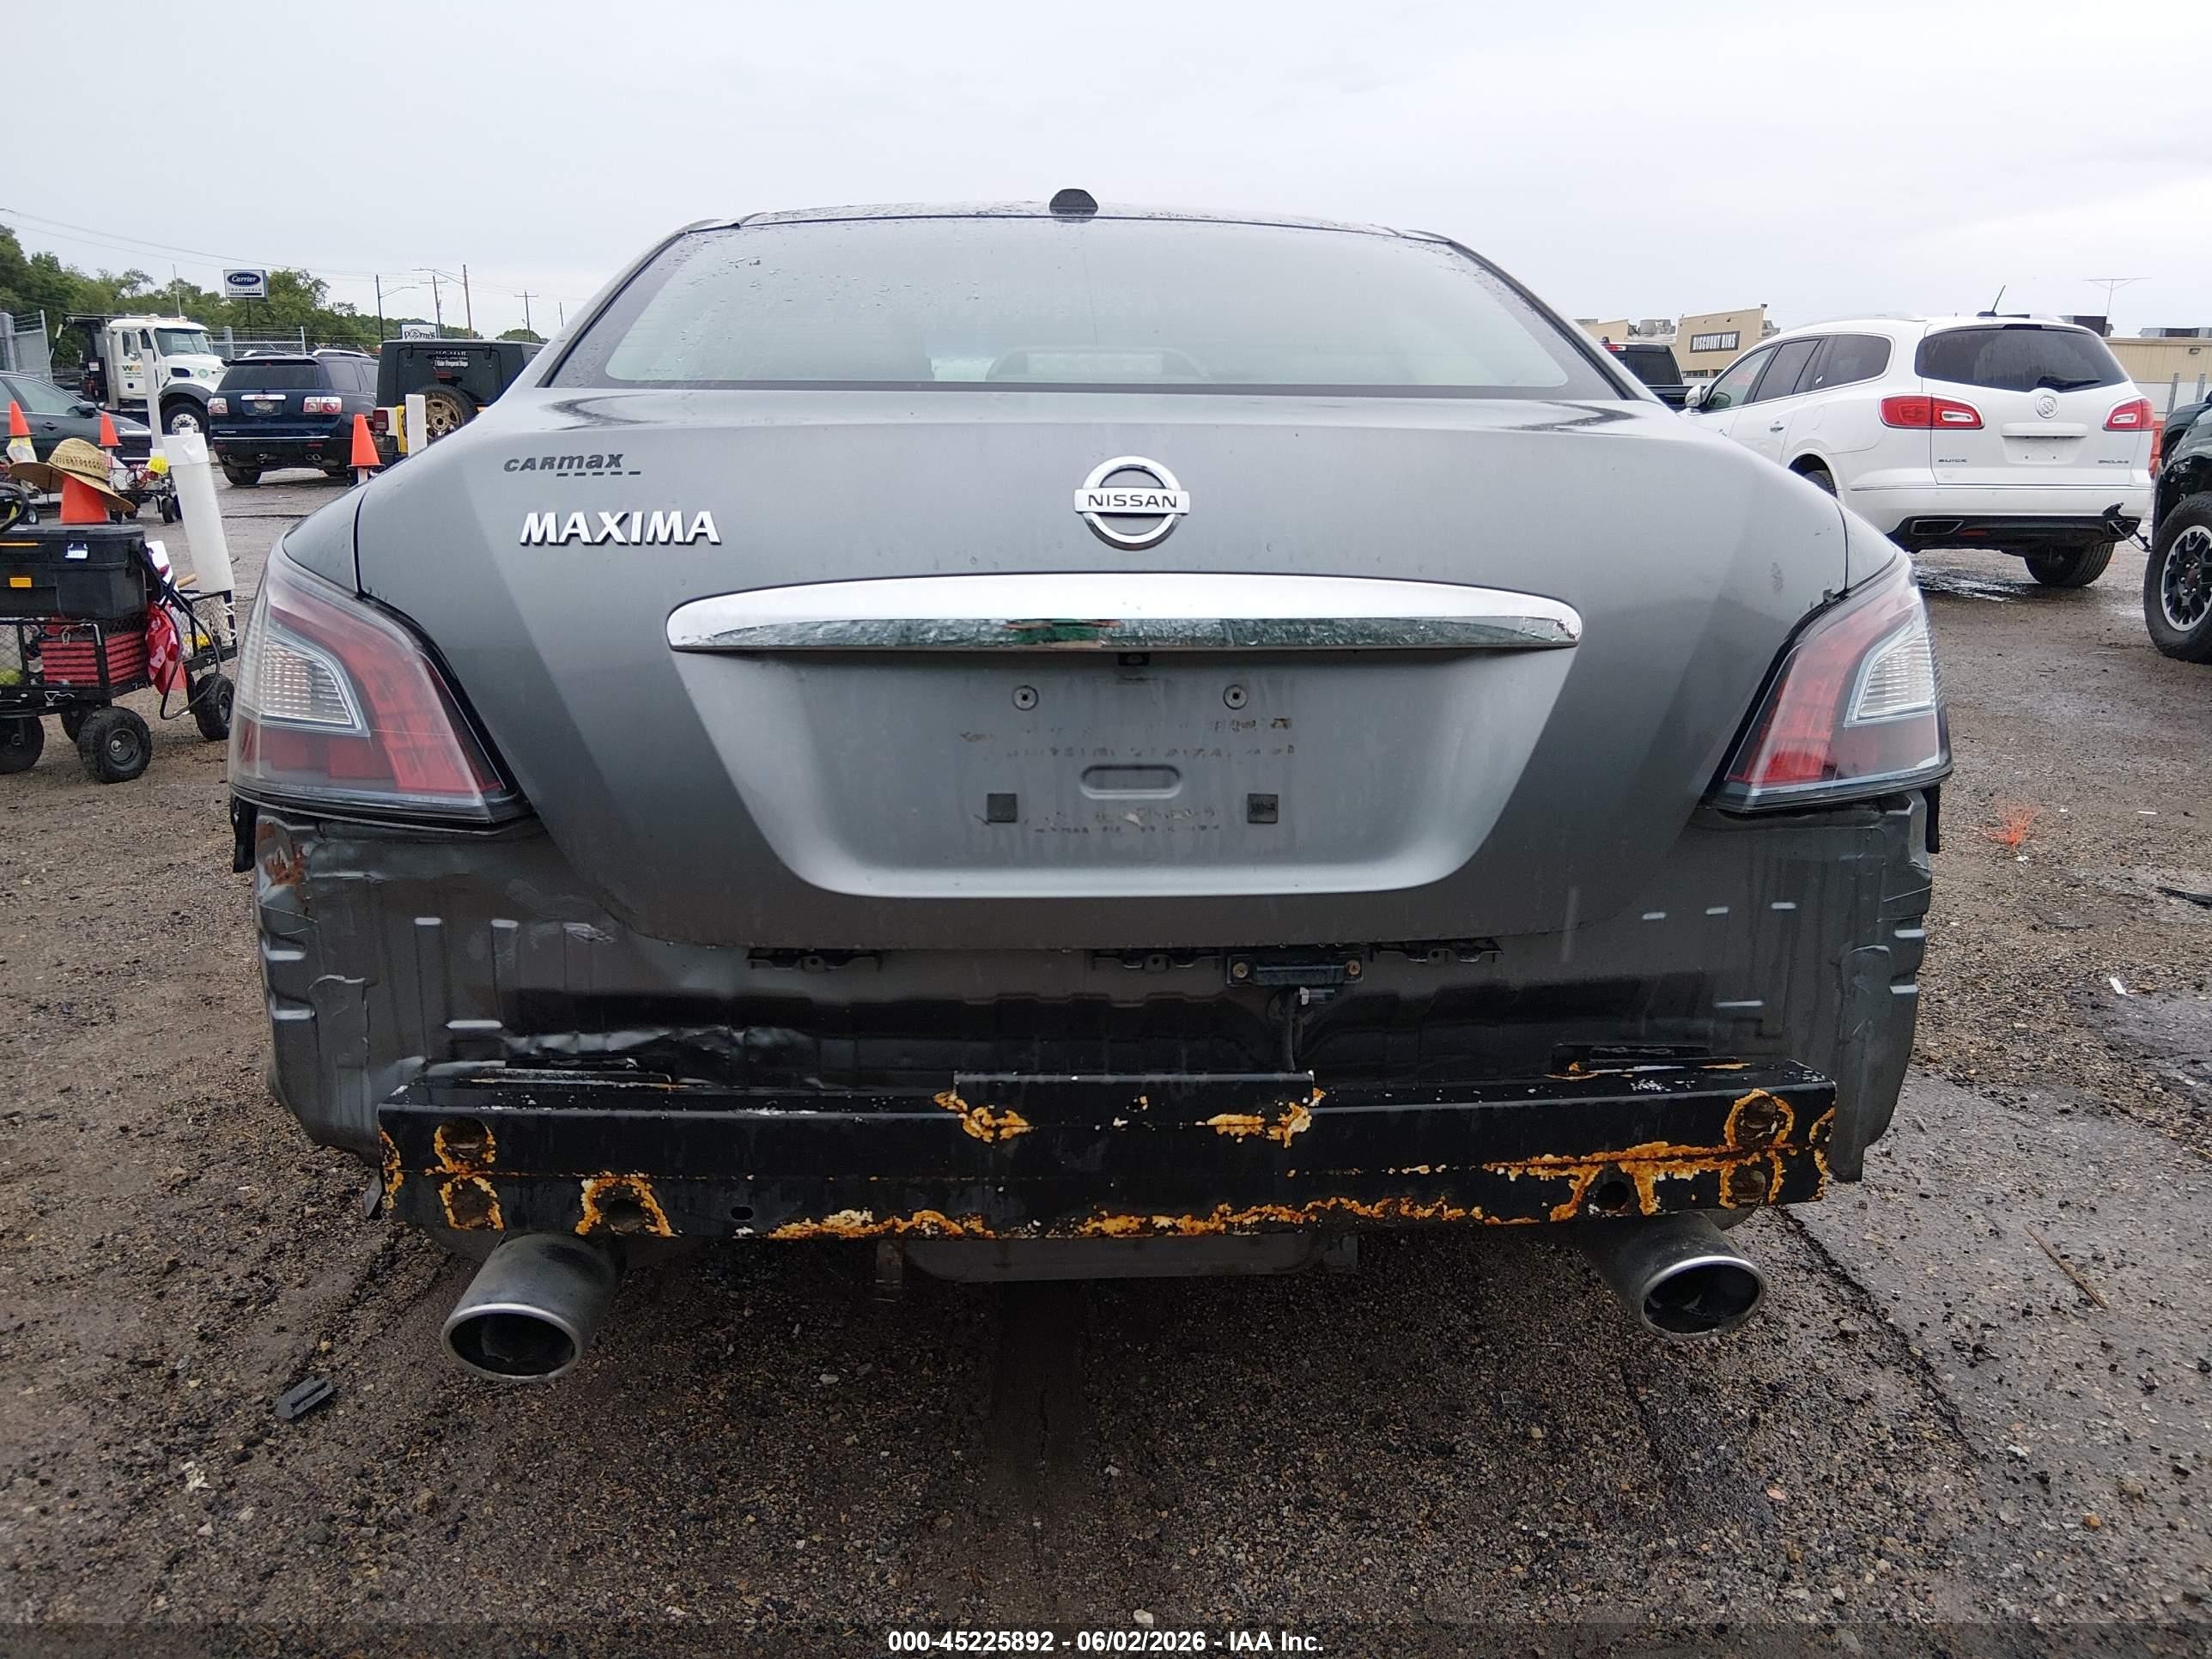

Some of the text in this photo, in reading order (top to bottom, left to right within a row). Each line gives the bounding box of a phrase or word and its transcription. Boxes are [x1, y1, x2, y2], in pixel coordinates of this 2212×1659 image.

[231, 275, 258, 283] Carrier
[1692, 335, 1722, 350] DISCOUNT
[1088, 494, 1177, 508] NISSAN
[520, 510, 722, 545] MAXIMA
